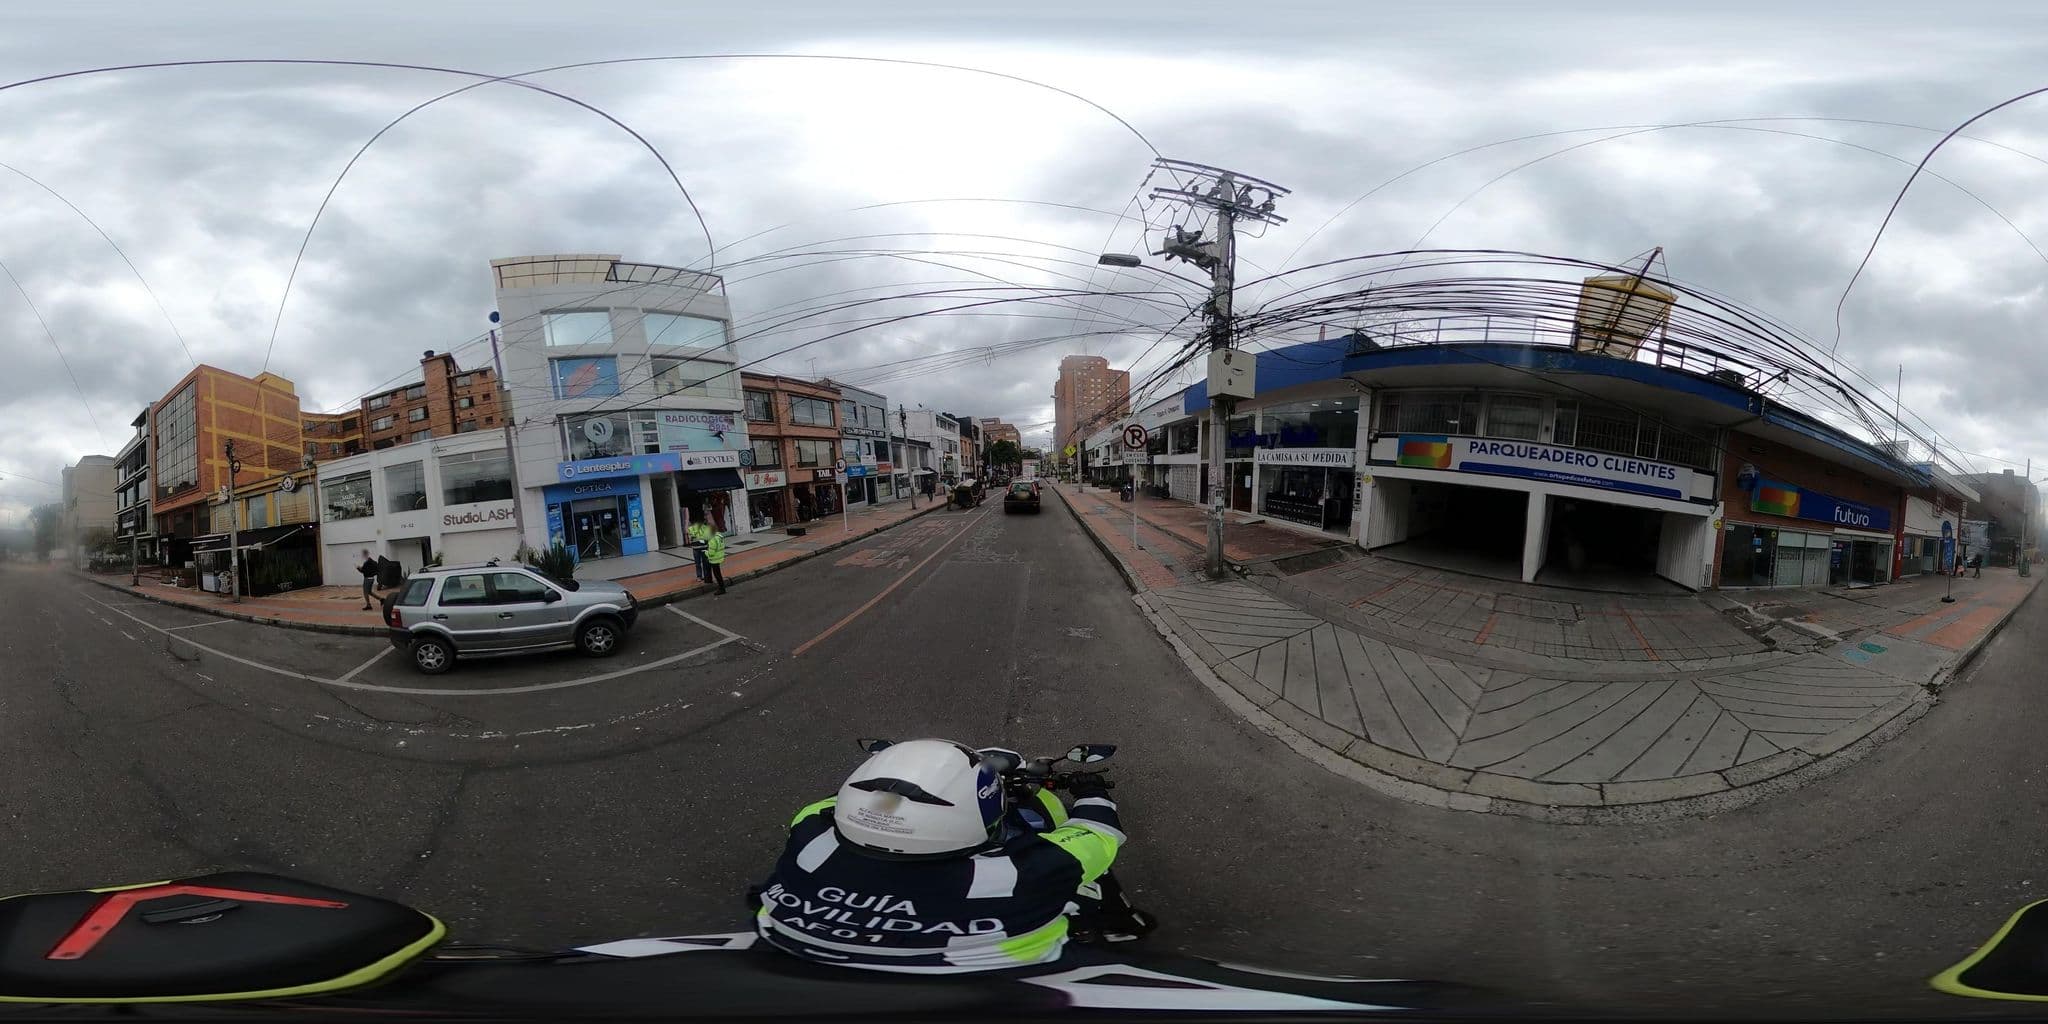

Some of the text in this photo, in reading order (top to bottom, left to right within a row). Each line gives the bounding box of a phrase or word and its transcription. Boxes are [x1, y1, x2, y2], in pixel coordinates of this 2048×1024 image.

[577, 461, 631, 474] Lentesplus
[703, 455, 735, 464] TEXTILES
[1257, 453, 1265, 461] LA
[1266, 453, 1292, 462] CAMISA
[1300, 454, 1310, 462] SU
[1312, 453, 1347, 463] MEDIDA
[1469, 441, 1676, 480] PARQUEADERO CLIENTES
[443, 507, 516, 526] StudioLASH
[1834, 506, 1870, 526] futuro
[767, 883, 1004, 935] MOVILIDAD
[816, 886, 917, 916] GUÍA
